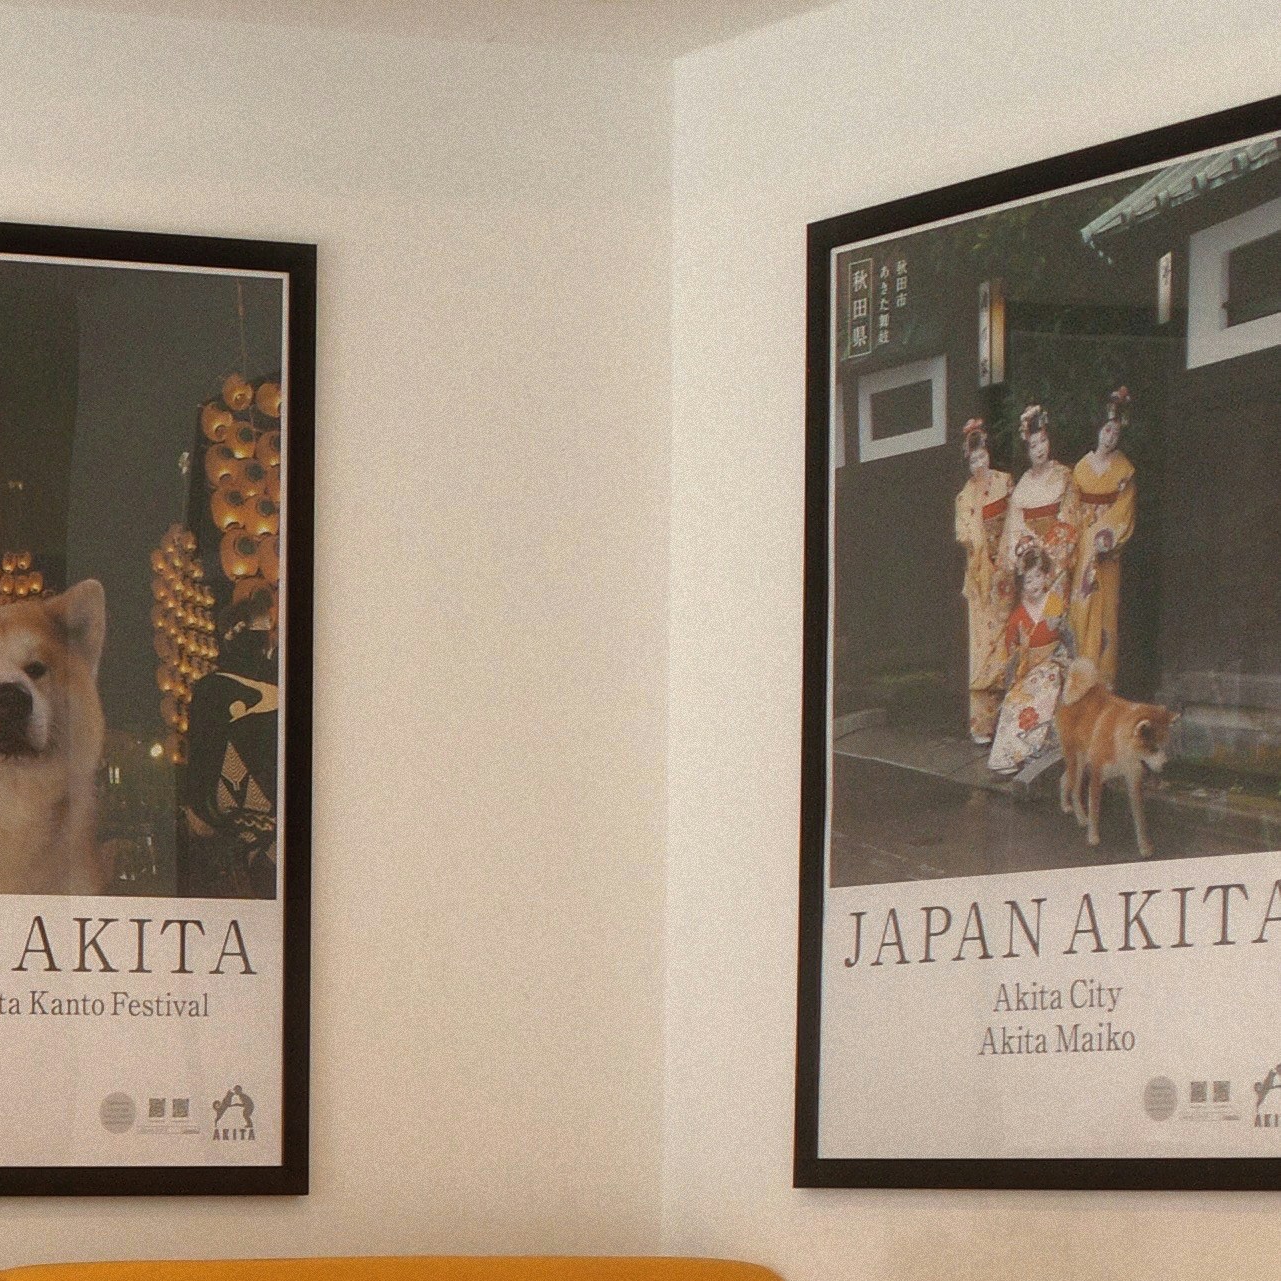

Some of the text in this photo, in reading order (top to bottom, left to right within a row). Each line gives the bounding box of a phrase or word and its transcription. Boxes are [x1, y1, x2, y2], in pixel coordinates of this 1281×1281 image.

[853, 270, 868, 347] 秋田県
[11, 915, 258, 976] AKITA
[844, 898, 1047, 969] JAPAN
[29, 990, 105, 1017] Kanto
[111, 991, 209, 1018] Festival
[993, 978, 1122, 1013] Akita City
[978, 1022, 1136, 1056] Akita Maiko
[212, 1127, 256, 1141] AKITA
